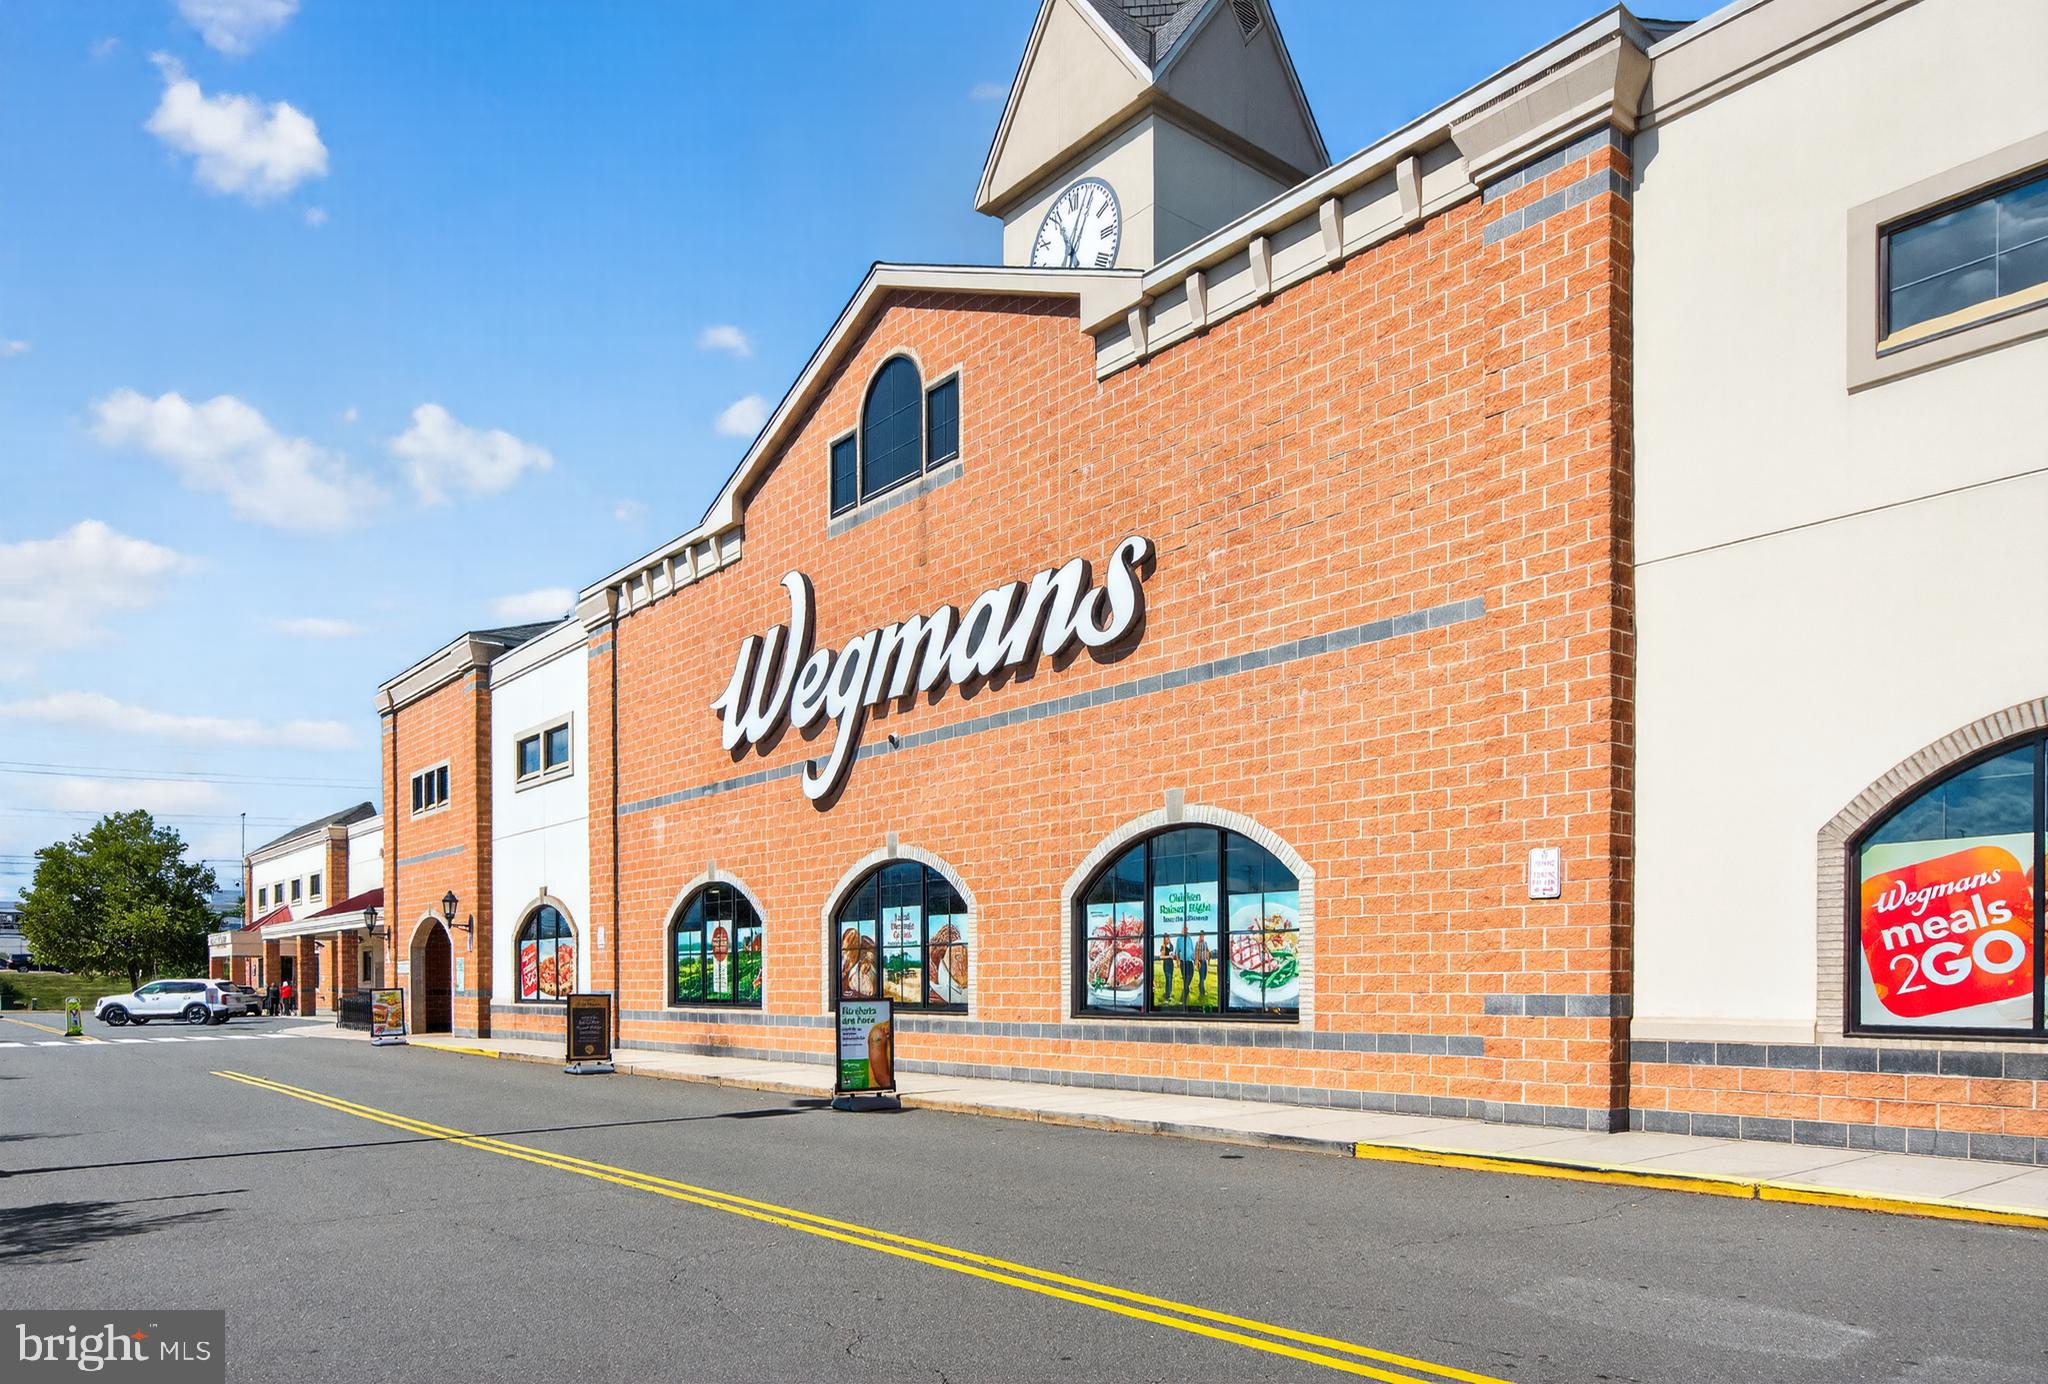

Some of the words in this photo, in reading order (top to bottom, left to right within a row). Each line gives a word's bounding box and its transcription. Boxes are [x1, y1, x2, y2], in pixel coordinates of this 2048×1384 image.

[710, 535, 1153, 804] Wegmans
[1168, 892, 1202, 903] Chiken
[1872, 868, 2002, 917] Wegmans
[1881, 893, 2013, 951] meals
[1889, 929, 2026, 995] 2GO
